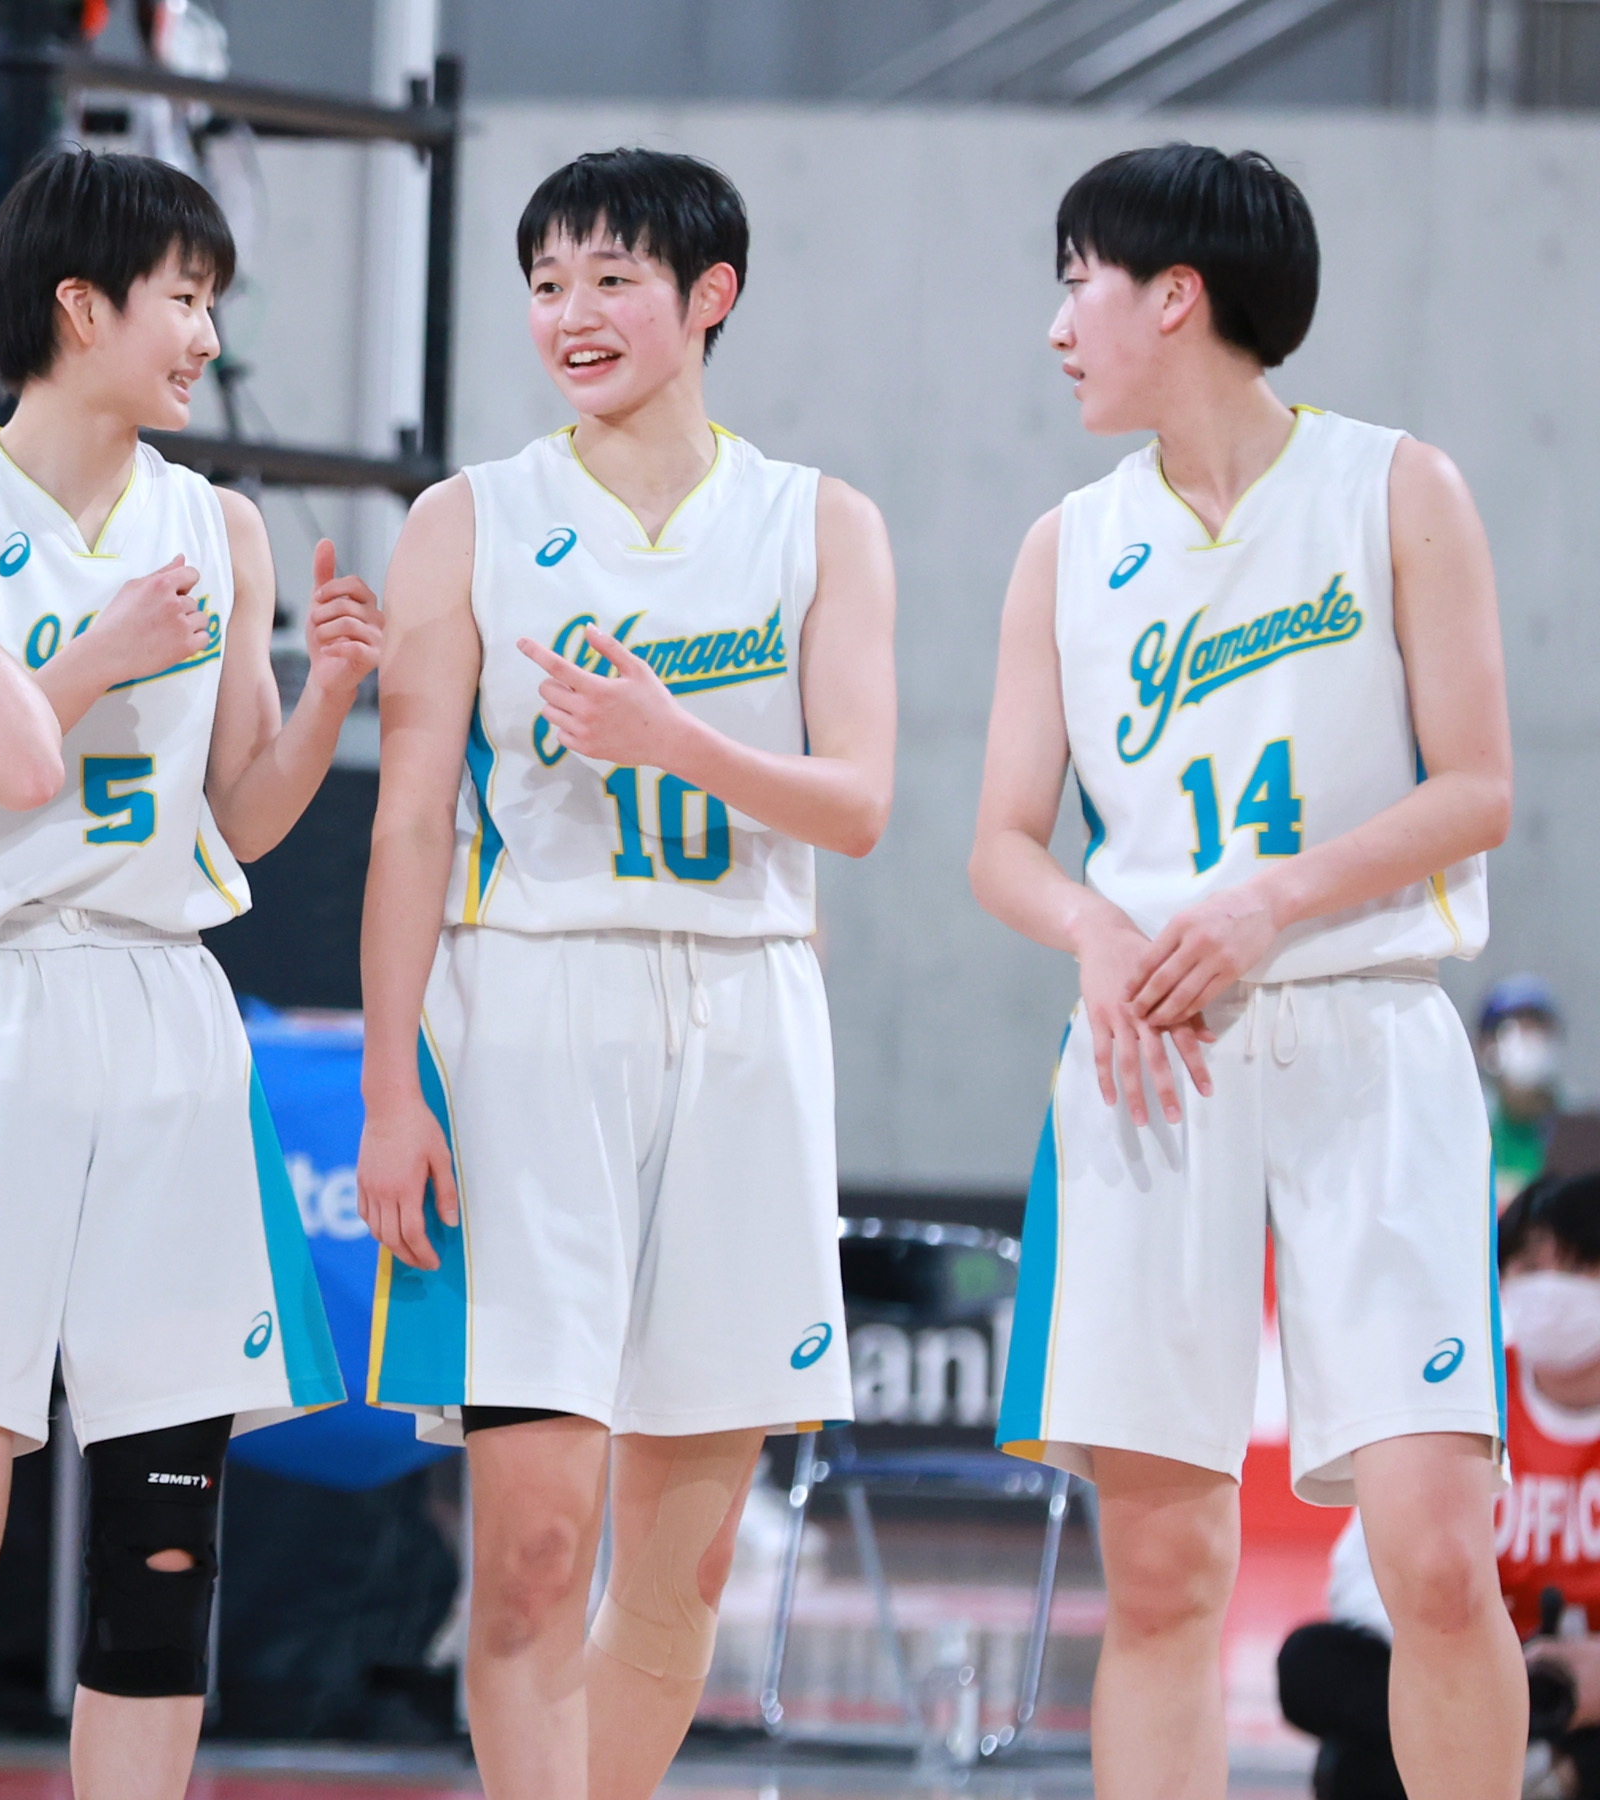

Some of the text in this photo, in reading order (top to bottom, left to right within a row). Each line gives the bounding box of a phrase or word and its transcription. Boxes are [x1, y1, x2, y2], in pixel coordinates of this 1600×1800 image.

[1115, 571, 1367, 767] Yamanote
[79, 753, 159, 848] 5
[600, 764, 735, 885] 10
[1176, 735, 1306, 877] 14
